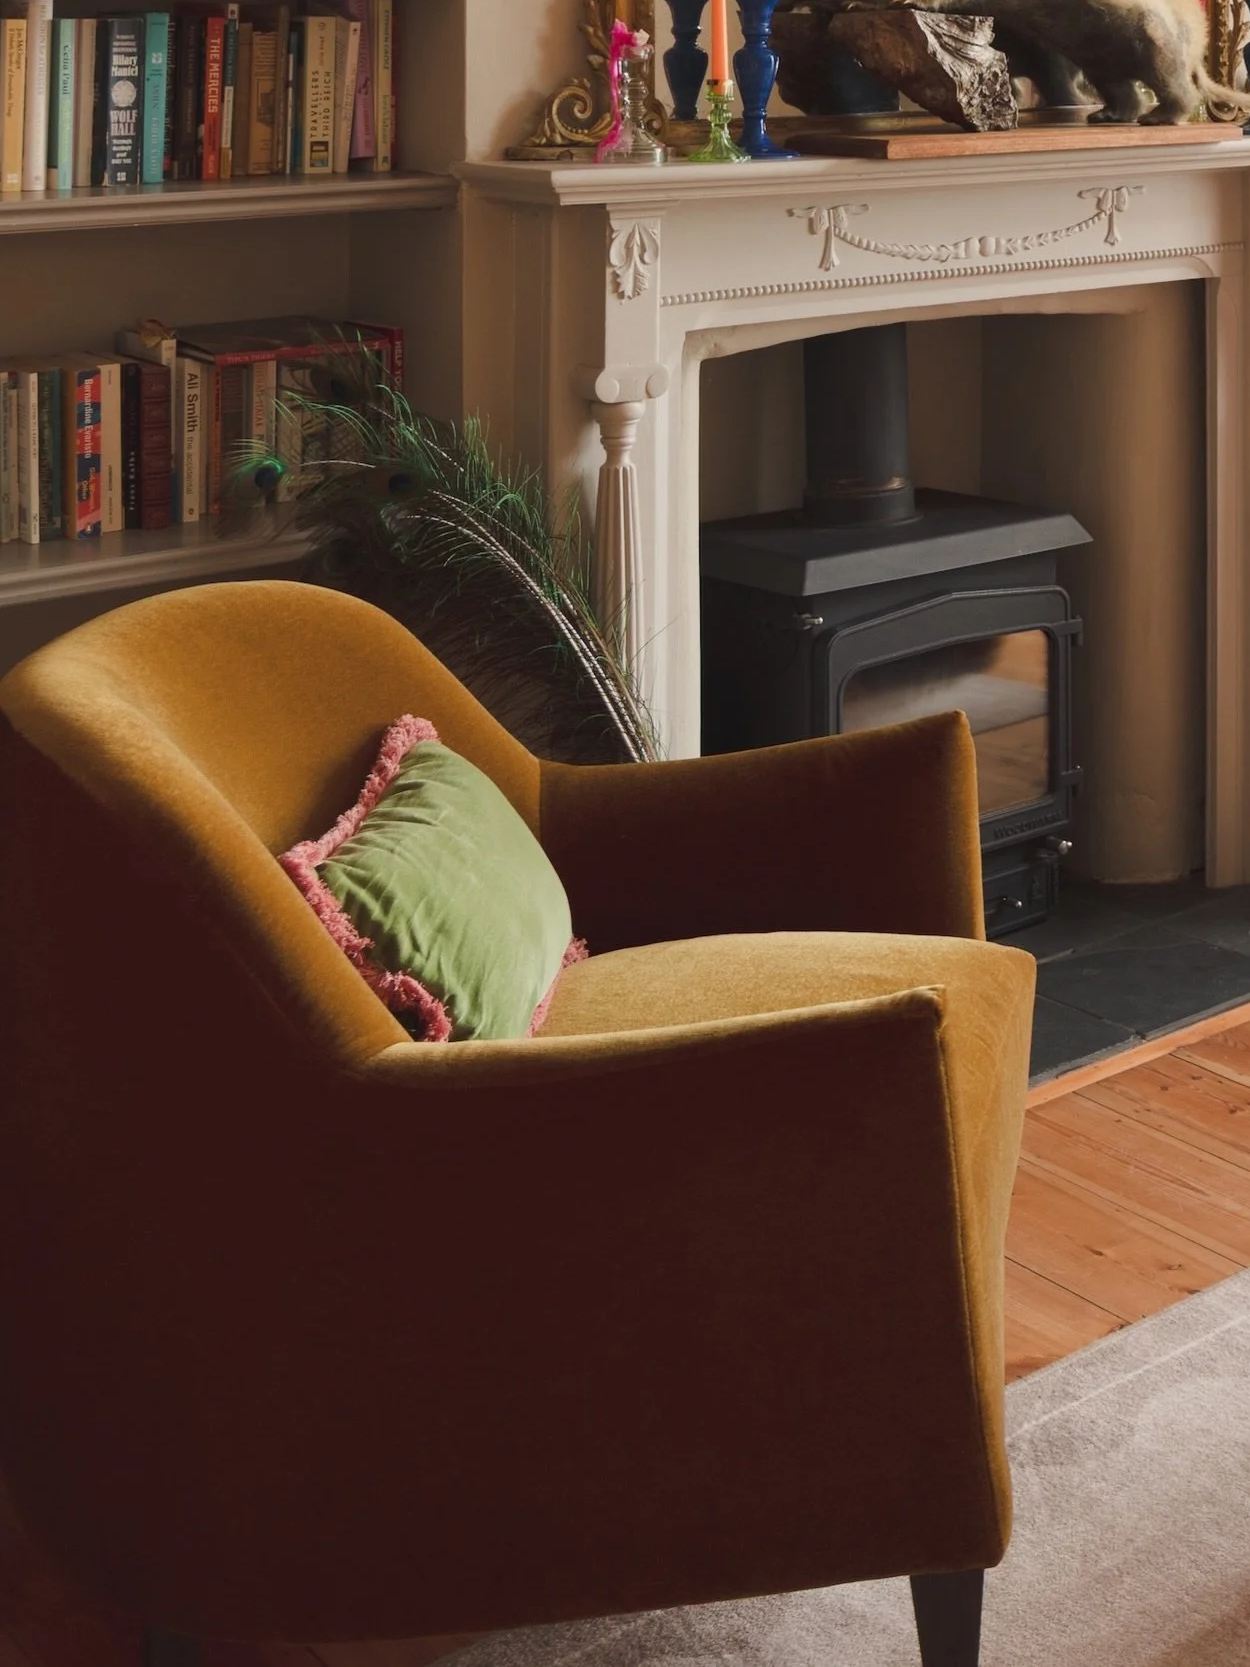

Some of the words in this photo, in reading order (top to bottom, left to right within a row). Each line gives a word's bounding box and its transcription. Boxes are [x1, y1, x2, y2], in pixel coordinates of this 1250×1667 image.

[62, 44, 71, 71] Celia
[210, 37, 221, 60] THE
[62, 73, 72, 96] Paul
[208, 62, 220, 114] MERCIES
[322, 71, 331, 102] REICH
[110, 110, 138, 122] WOLF
[311, 70, 319, 138] TRAVELLERS
[110, 122, 137, 135] HALL
[322, 108, 331, 138] THIRD
[84, 378, 95, 424] Bernardine
[187, 393, 199, 433] Smith
[84, 425, 94, 460] Evaristo
